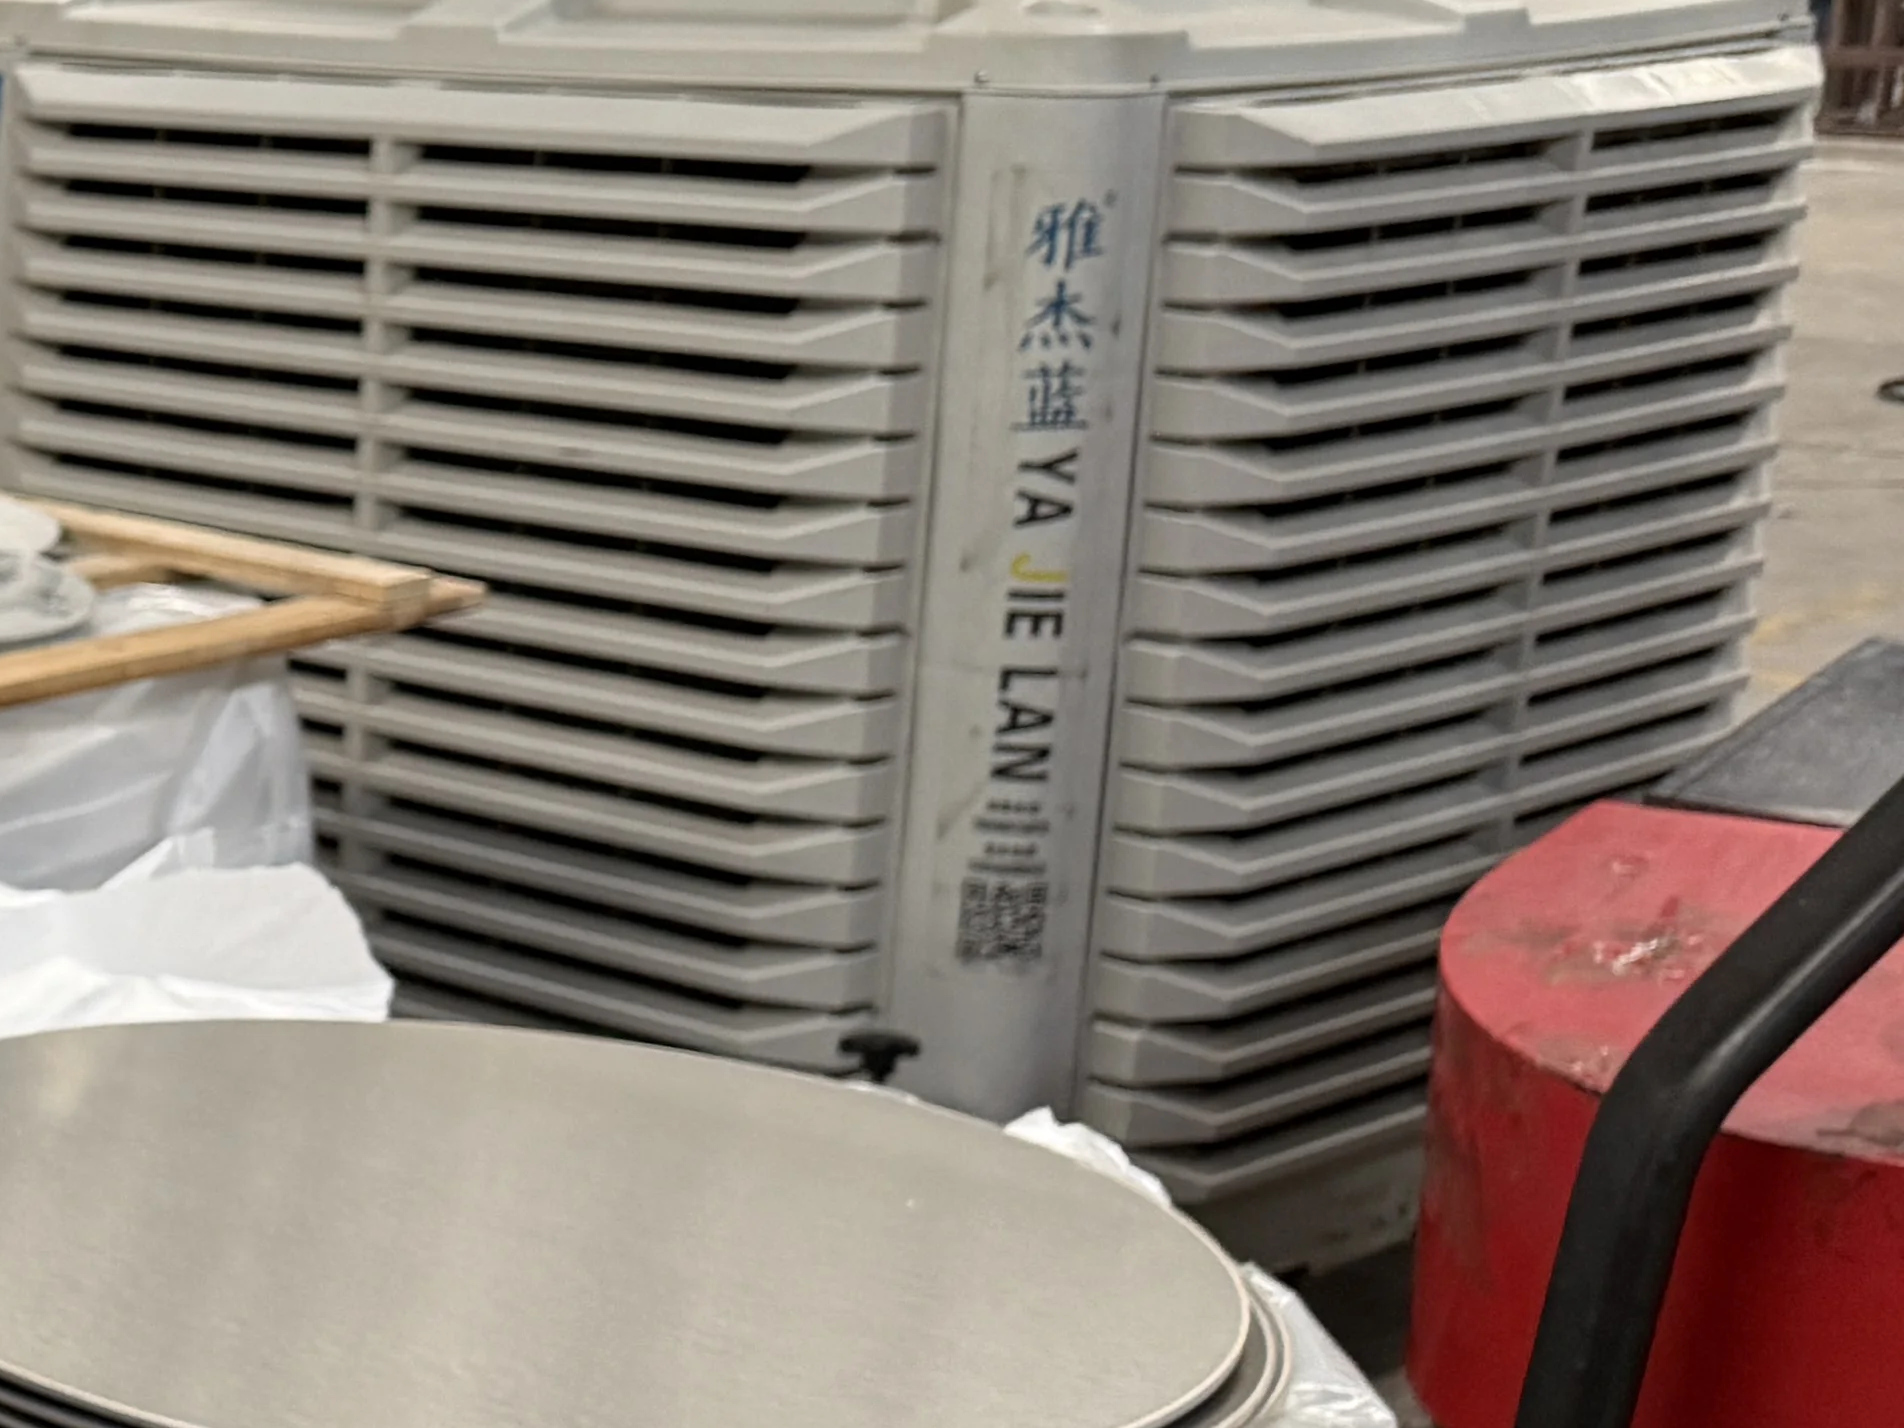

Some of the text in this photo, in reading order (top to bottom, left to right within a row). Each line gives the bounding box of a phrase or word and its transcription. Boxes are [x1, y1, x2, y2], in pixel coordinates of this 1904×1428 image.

[1009, 198, 1105, 431] 雅杰蓝
[1011, 446, 1080, 530] YA
[1002, 552, 1071, 641] JIE
[990, 667, 1060, 783] LAN
